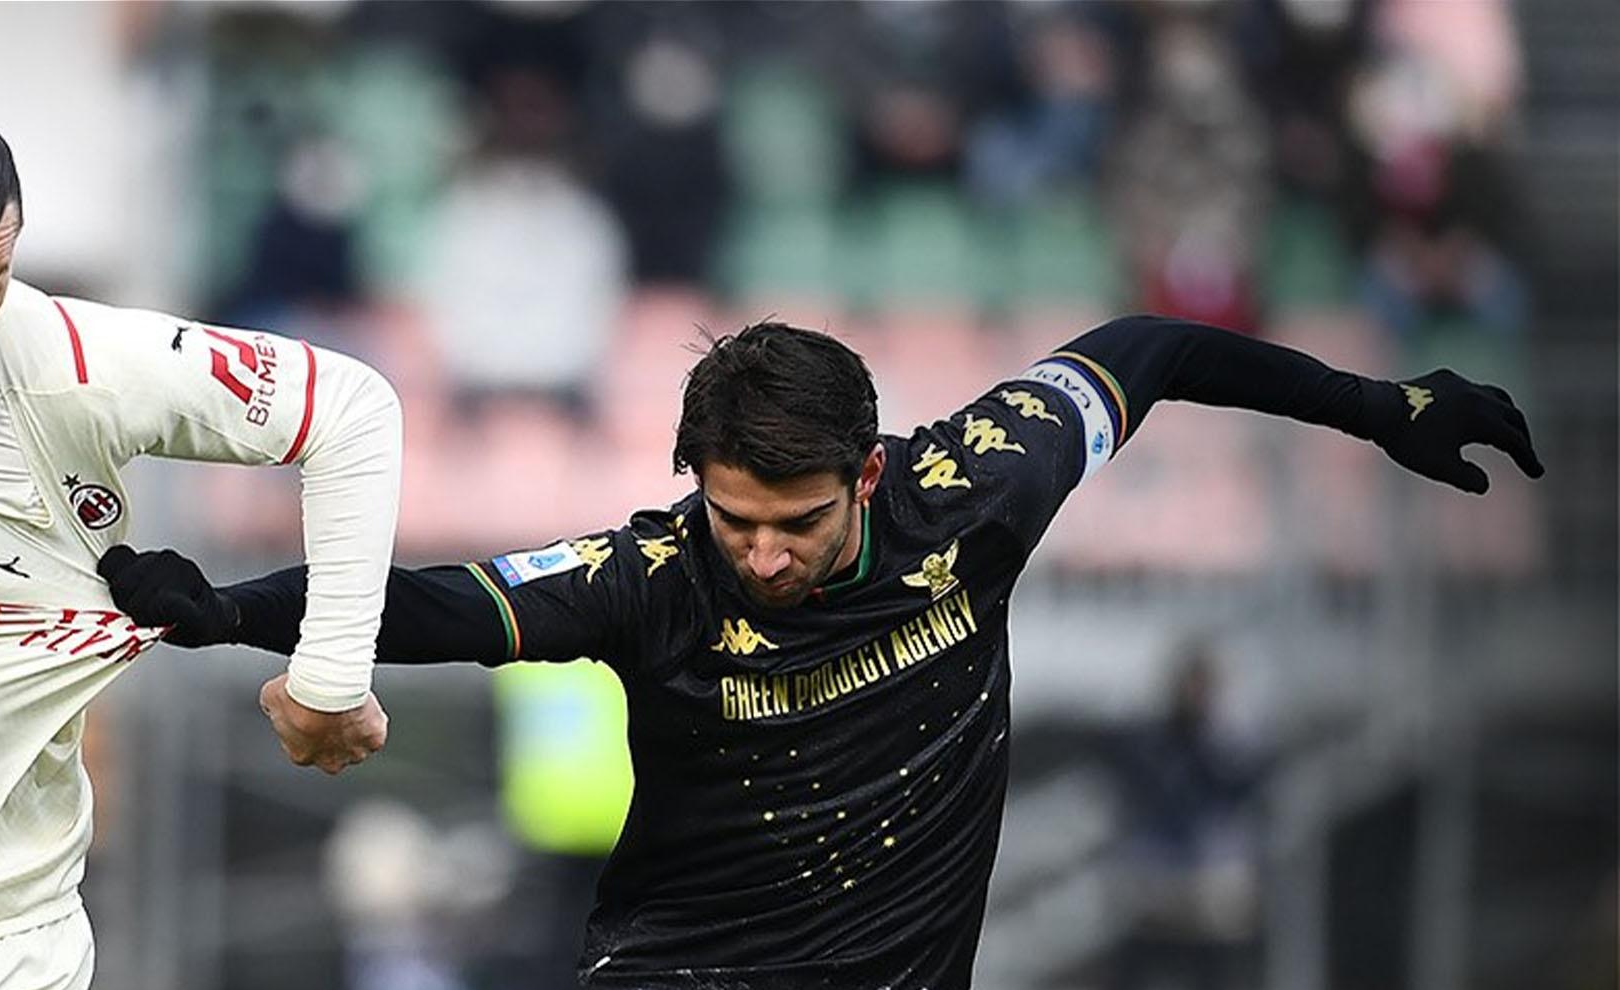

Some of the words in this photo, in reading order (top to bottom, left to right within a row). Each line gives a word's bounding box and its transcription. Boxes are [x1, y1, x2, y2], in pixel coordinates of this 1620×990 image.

[721, 674, 789, 720] GREEN
[794, 641, 891, 711] PROJECT
[889, 590, 978, 670] AGENCY
